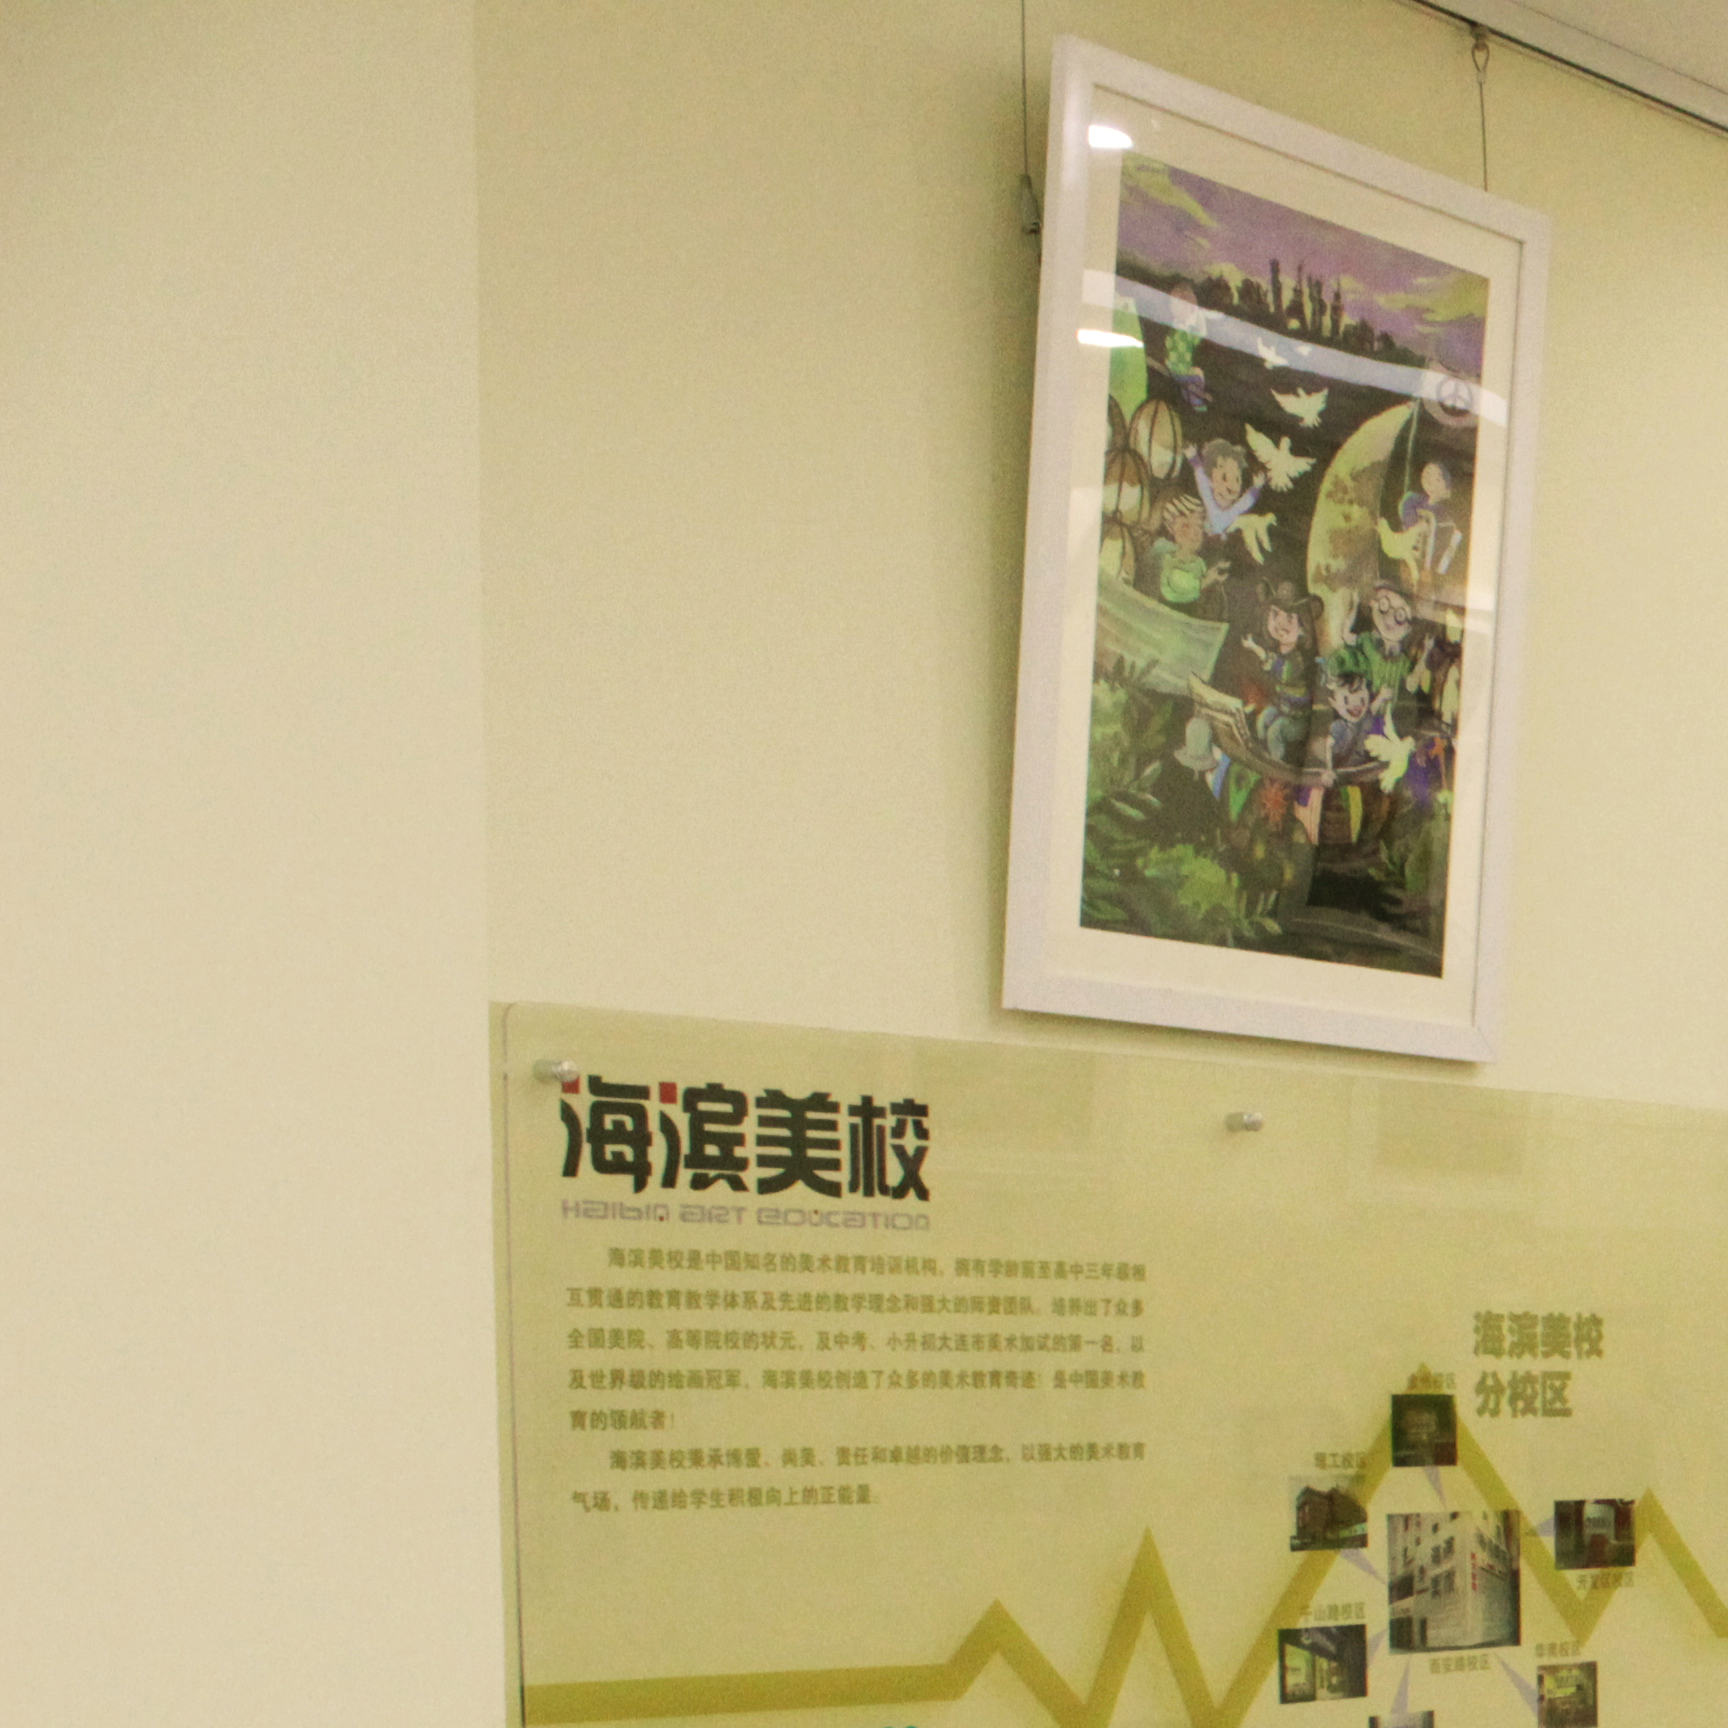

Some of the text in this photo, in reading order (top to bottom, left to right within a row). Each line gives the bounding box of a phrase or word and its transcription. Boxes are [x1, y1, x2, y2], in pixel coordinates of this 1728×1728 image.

[560, 1074, 931, 1203] 海滨美校
[1473, 1310, 1605, 1361] 海滨美校
[1474, 1370, 1574, 1419] 分校区
